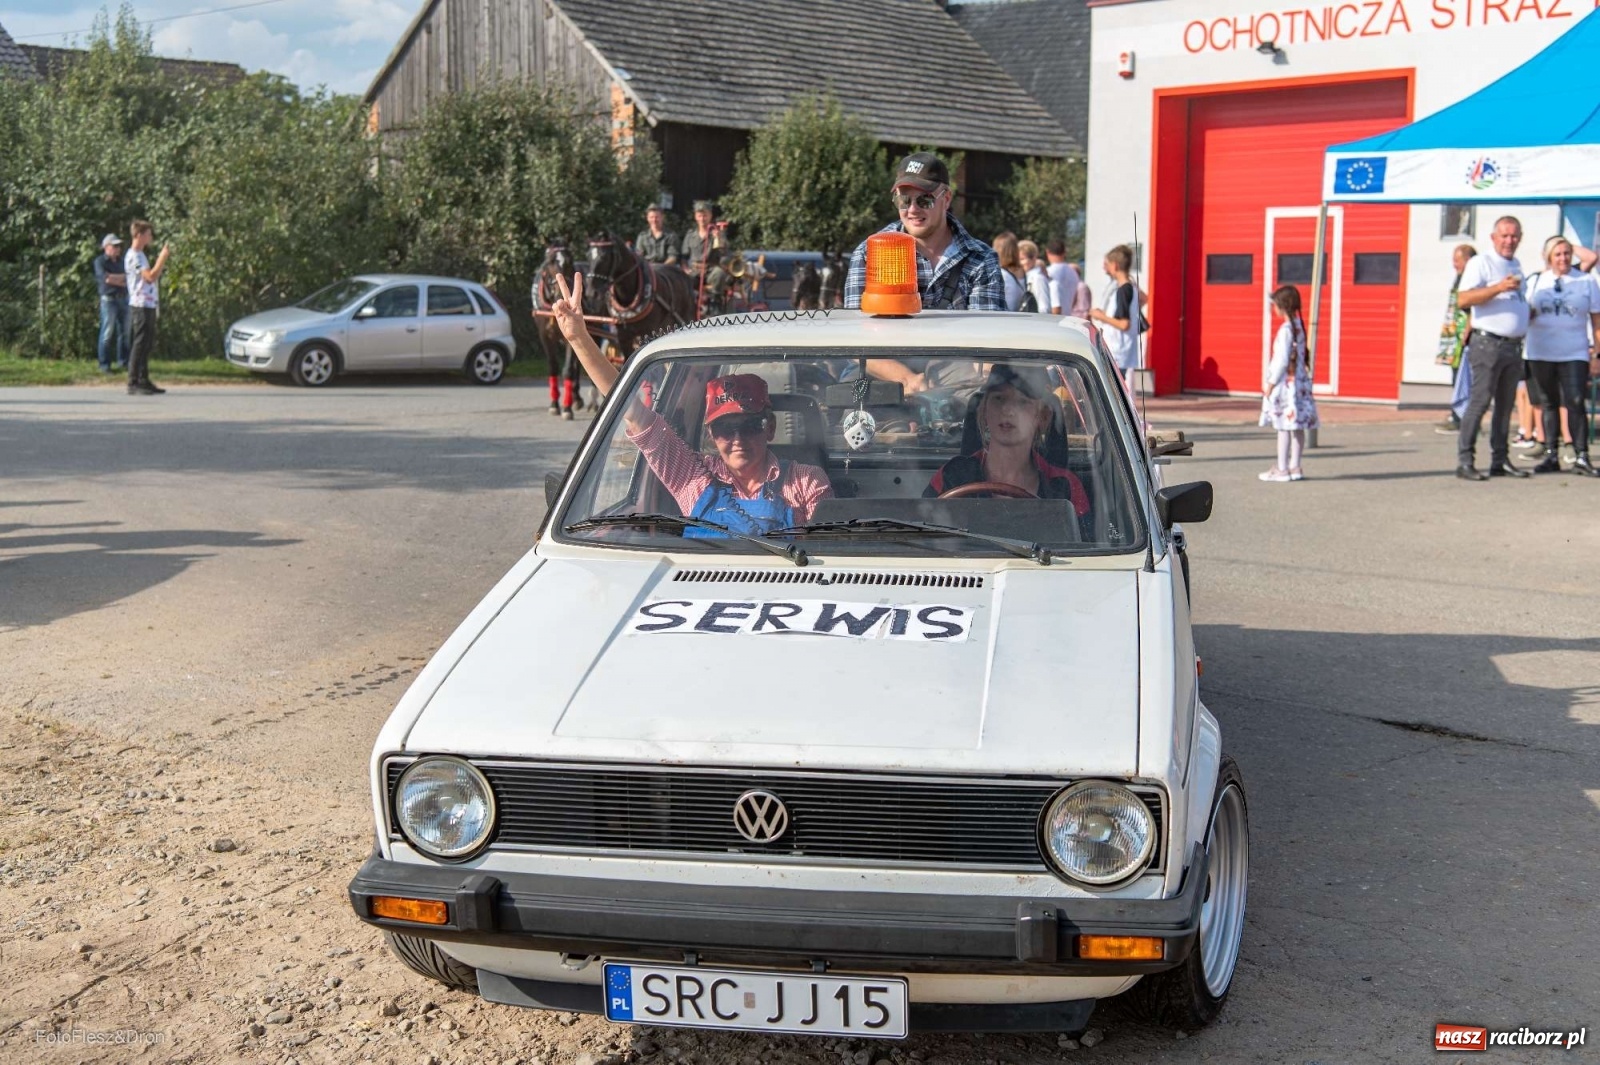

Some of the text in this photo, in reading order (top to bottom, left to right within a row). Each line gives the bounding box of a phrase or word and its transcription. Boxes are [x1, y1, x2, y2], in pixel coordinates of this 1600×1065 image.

[1184, 0, 1410, 53] OCHOTNICZA
[635, 601, 965, 639] SERWIS
[612, 998, 630, 1011] PL
[642, 973, 739, 1020] SRC
